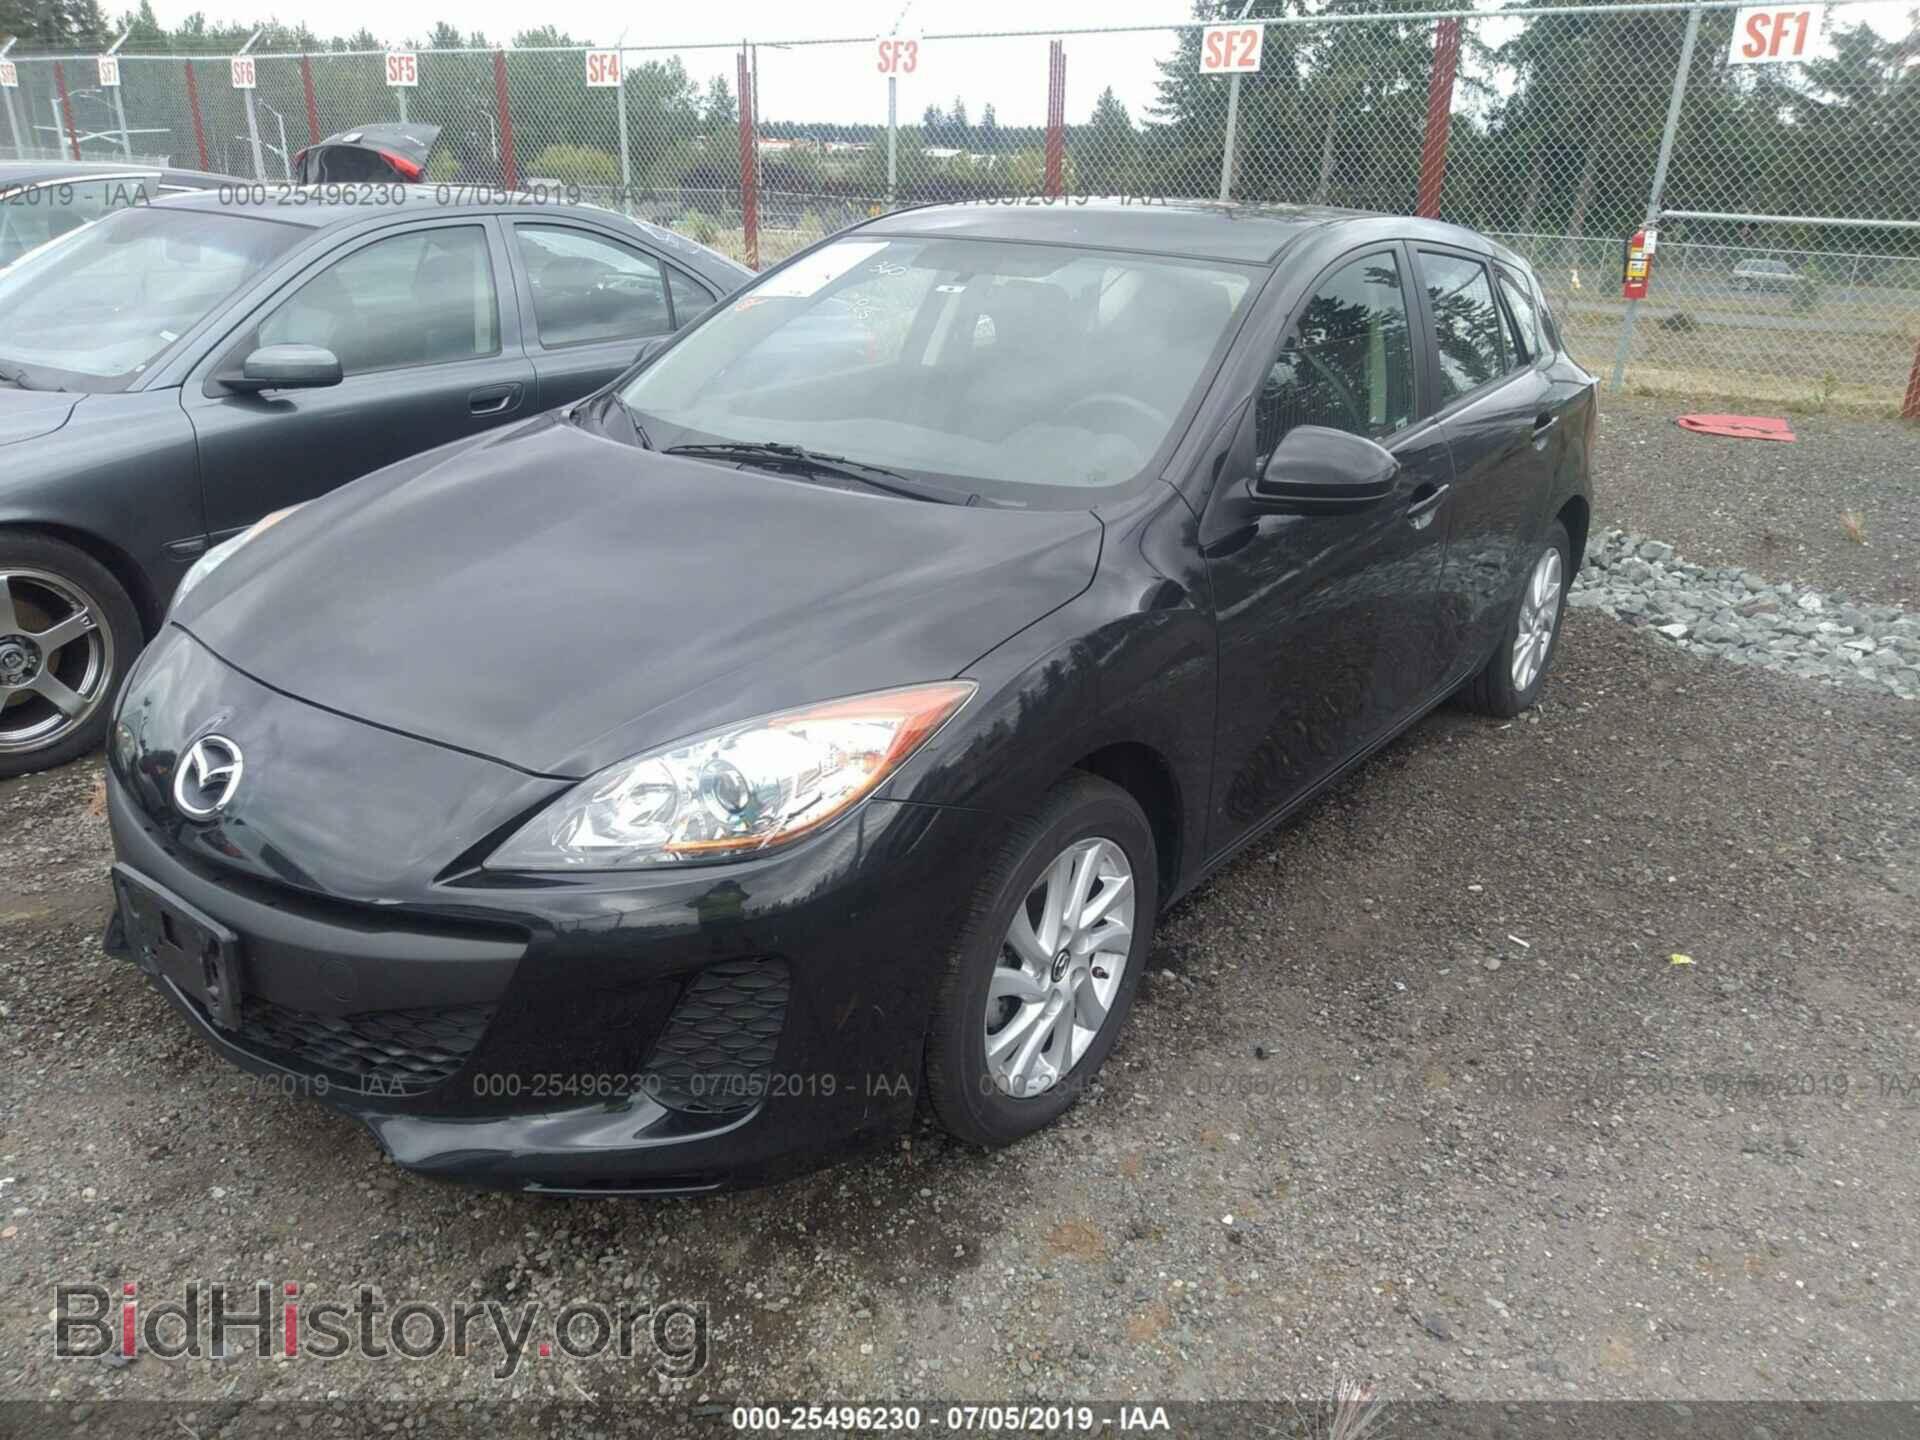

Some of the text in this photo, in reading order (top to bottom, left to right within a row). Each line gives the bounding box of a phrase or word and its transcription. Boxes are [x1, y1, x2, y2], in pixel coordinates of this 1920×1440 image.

[1205, 30, 1258, 68] SF2
[1742, 11, 1810, 58] SF1
[388, 56, 415, 82] SF5
[588, 53, 619, 83] SF4
[877, 40, 918, 73] SF3
[233, 62, 254, 85] SF6
